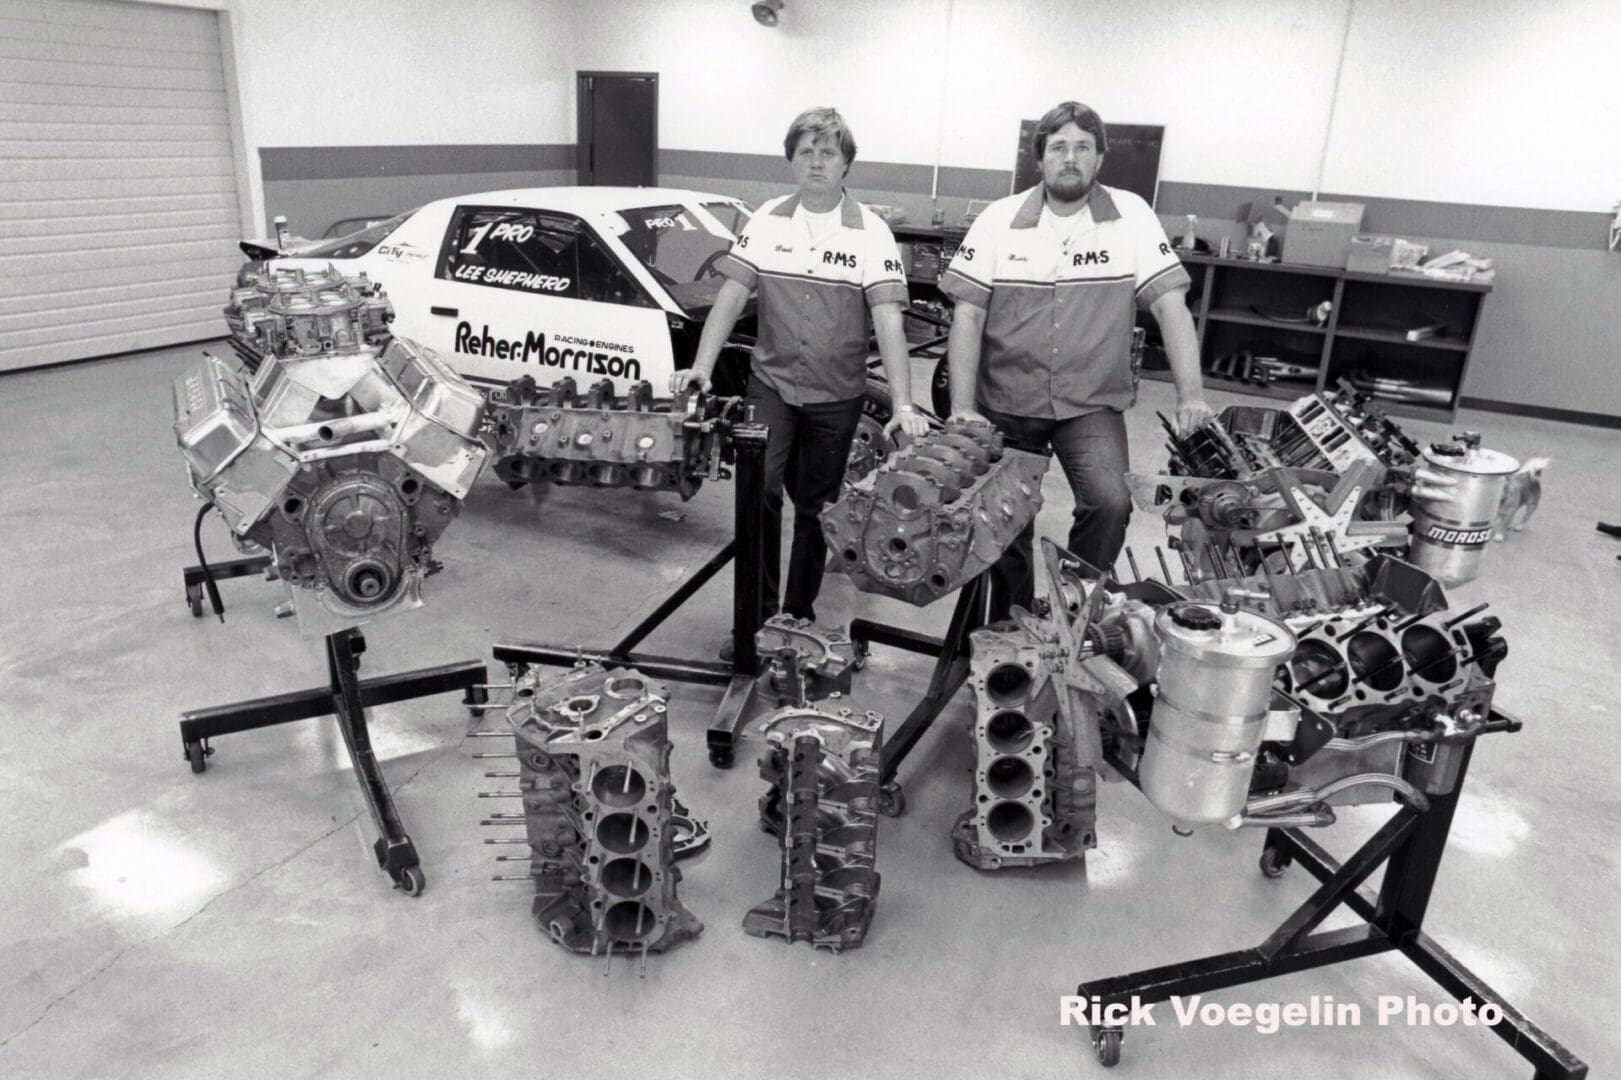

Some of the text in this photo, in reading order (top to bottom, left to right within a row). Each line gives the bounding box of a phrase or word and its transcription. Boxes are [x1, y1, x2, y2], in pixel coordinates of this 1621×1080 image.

[645, 213, 698, 231] PRO 1
[459, 222, 534, 255] 1 PRO
[455, 264, 571, 291] LEE SHEPHERD
